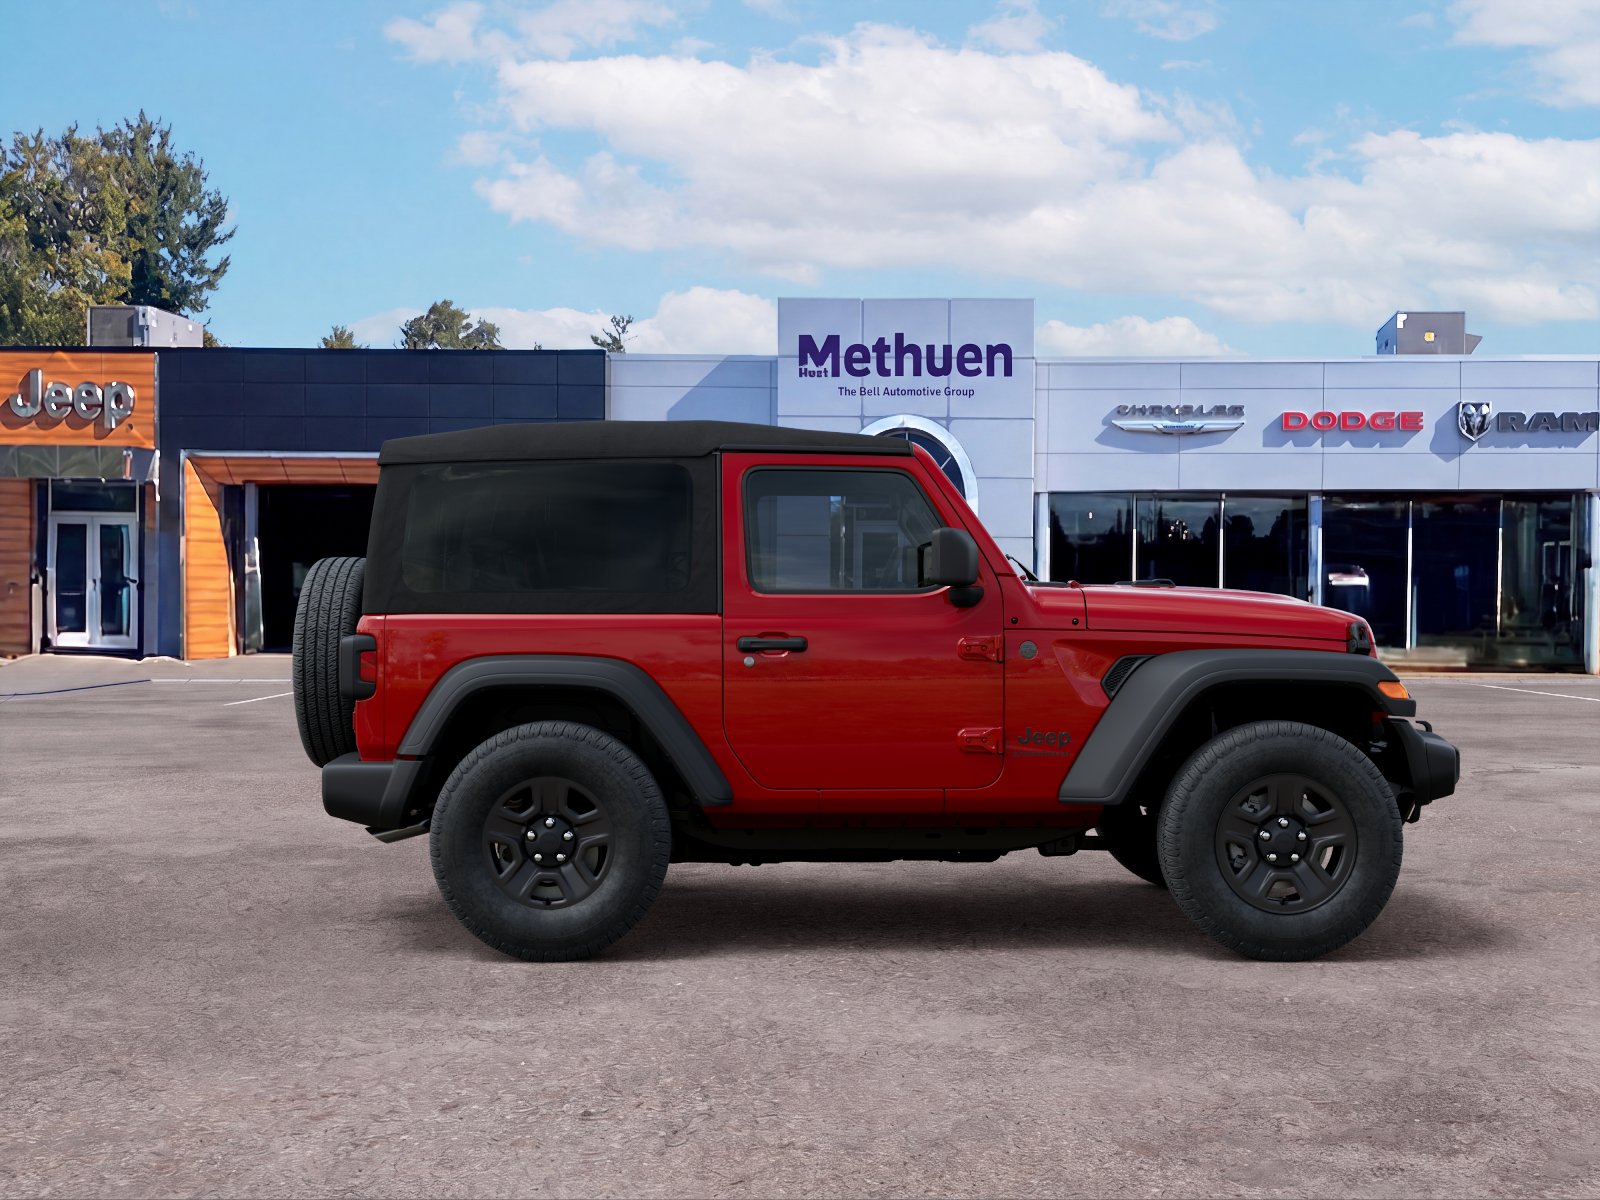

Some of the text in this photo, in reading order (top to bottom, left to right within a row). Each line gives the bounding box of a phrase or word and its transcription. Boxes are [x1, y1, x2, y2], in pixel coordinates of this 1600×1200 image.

[798, 332, 1013, 378] Methuen
[8, 367, 135, 430] Jeep
[838, 386, 975, 399] The Bell Automotive Group
[1282, 411, 1424, 432] DODGE
[1498, 411, 1600, 432] RAM
[1017, 727, 1071, 748] Jeep
